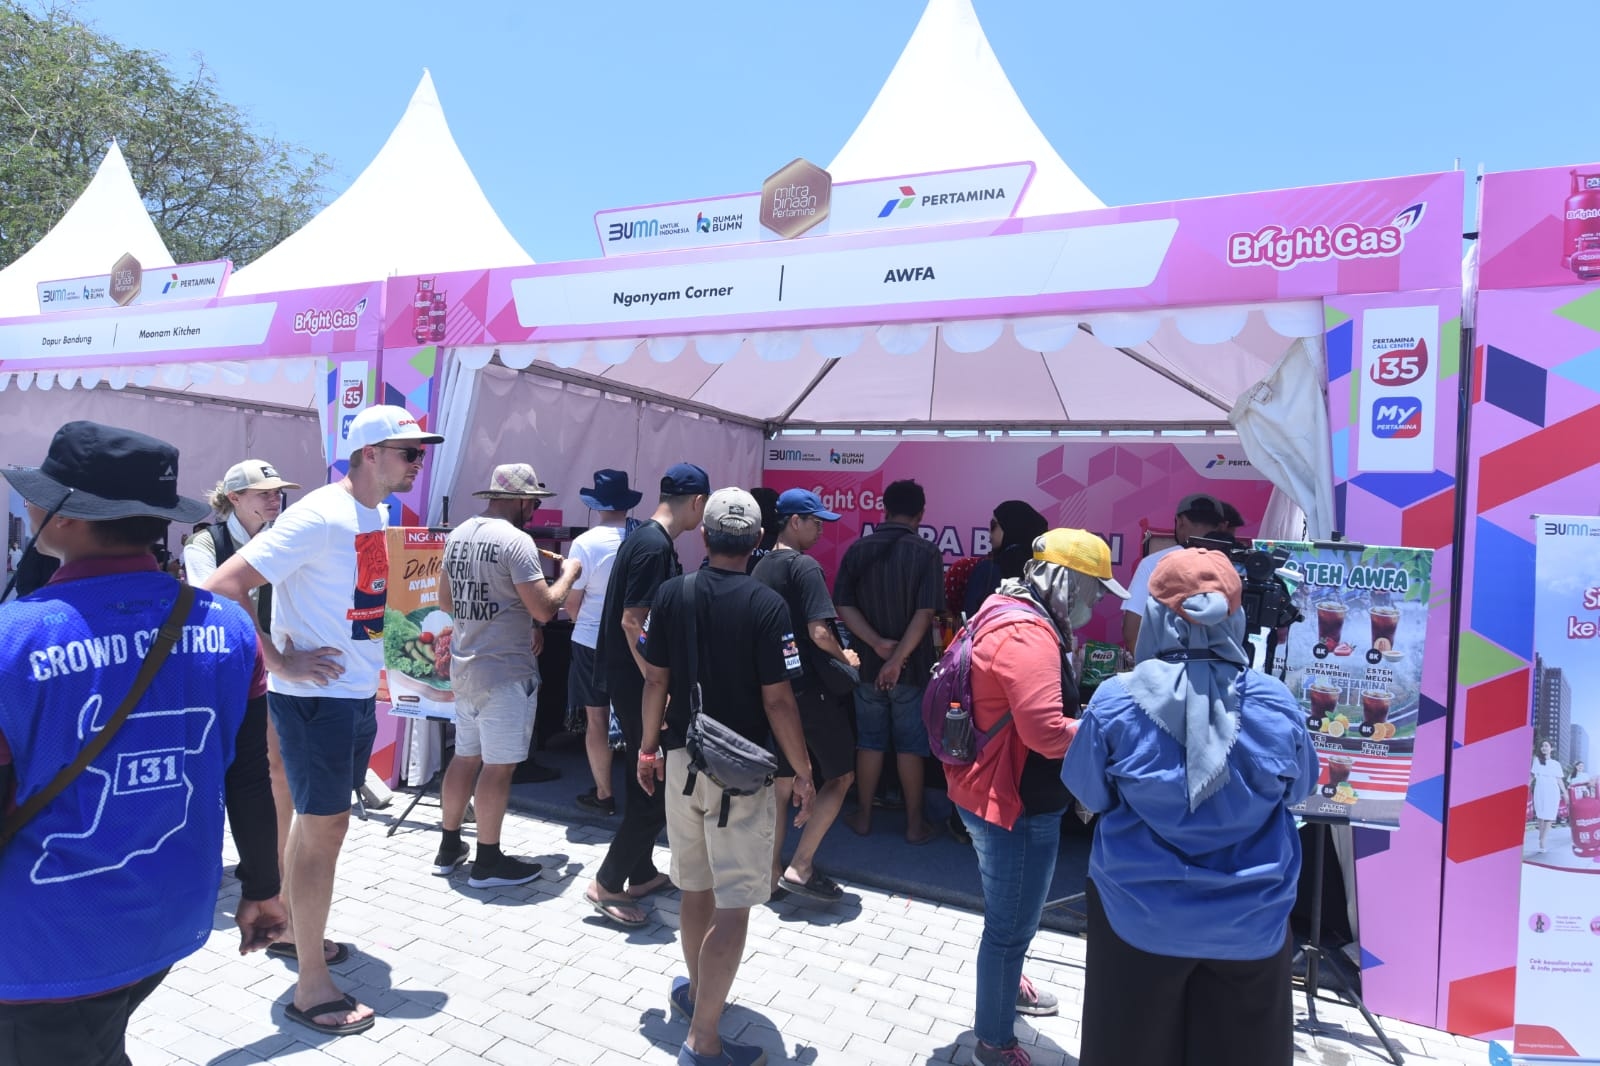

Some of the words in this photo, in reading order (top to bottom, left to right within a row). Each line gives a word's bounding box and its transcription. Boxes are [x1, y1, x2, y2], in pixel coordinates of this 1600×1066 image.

[774, 184, 809, 199] mitra
[922, 187, 1006, 207] PERTAMINA
[773, 195, 816, 209] binaan
[712, 213, 743, 222] RUMAH
[772, 206, 816, 218] Pertamina
[609, 218, 659, 241] BUMN
[659, 227, 690, 236] INDONESIA
[712, 221, 743, 232] BUMN
[1231, 226, 1329, 264] Bright
[1334, 226, 1399, 252] Gas
[180, 277, 216, 288] PERTAMINA
[884, 266, 935, 284] AWFA
[613, 290, 681, 307] Ngonyam
[685, 285, 734, 300] Corner
[295, 310, 331, 331] Bright
[333, 311, 358, 327] Gas
[173, 325, 201, 337] Kitchen
[62, 334, 93, 346] Bandung
[1372, 357, 1419, 380] 135
[344, 390, 361, 405] 135
[1376, 405, 1418, 424] My
[769, 450, 802, 460] BUMN
[859, 490, 886, 510] Ga
[1544, 523, 1589, 537] BUMN
[476, 542, 500, 564] THE
[408, 577, 436, 592] AYAM
[1305, 563, 1344, 586] TEH
[1349, 567, 1409, 591] AWFA
[453, 580, 466, 600] BY
[467, 581, 489, 602] THE
[454, 601, 500, 621] RD.NXP
[1569, 617, 1595, 637] ke
[29, 634, 129, 681] CROWD
[1091, 653, 1113, 661] MILO
[1315, 647, 1327, 655] 8K
[1368, 653, 1380, 661] 8K
[1330, 677, 1388, 690] PERTAMINA
[1365, 675, 1393, 683] MELON
[1360, 748, 1388, 757] JERUK
[127, 755, 177, 787] 131
